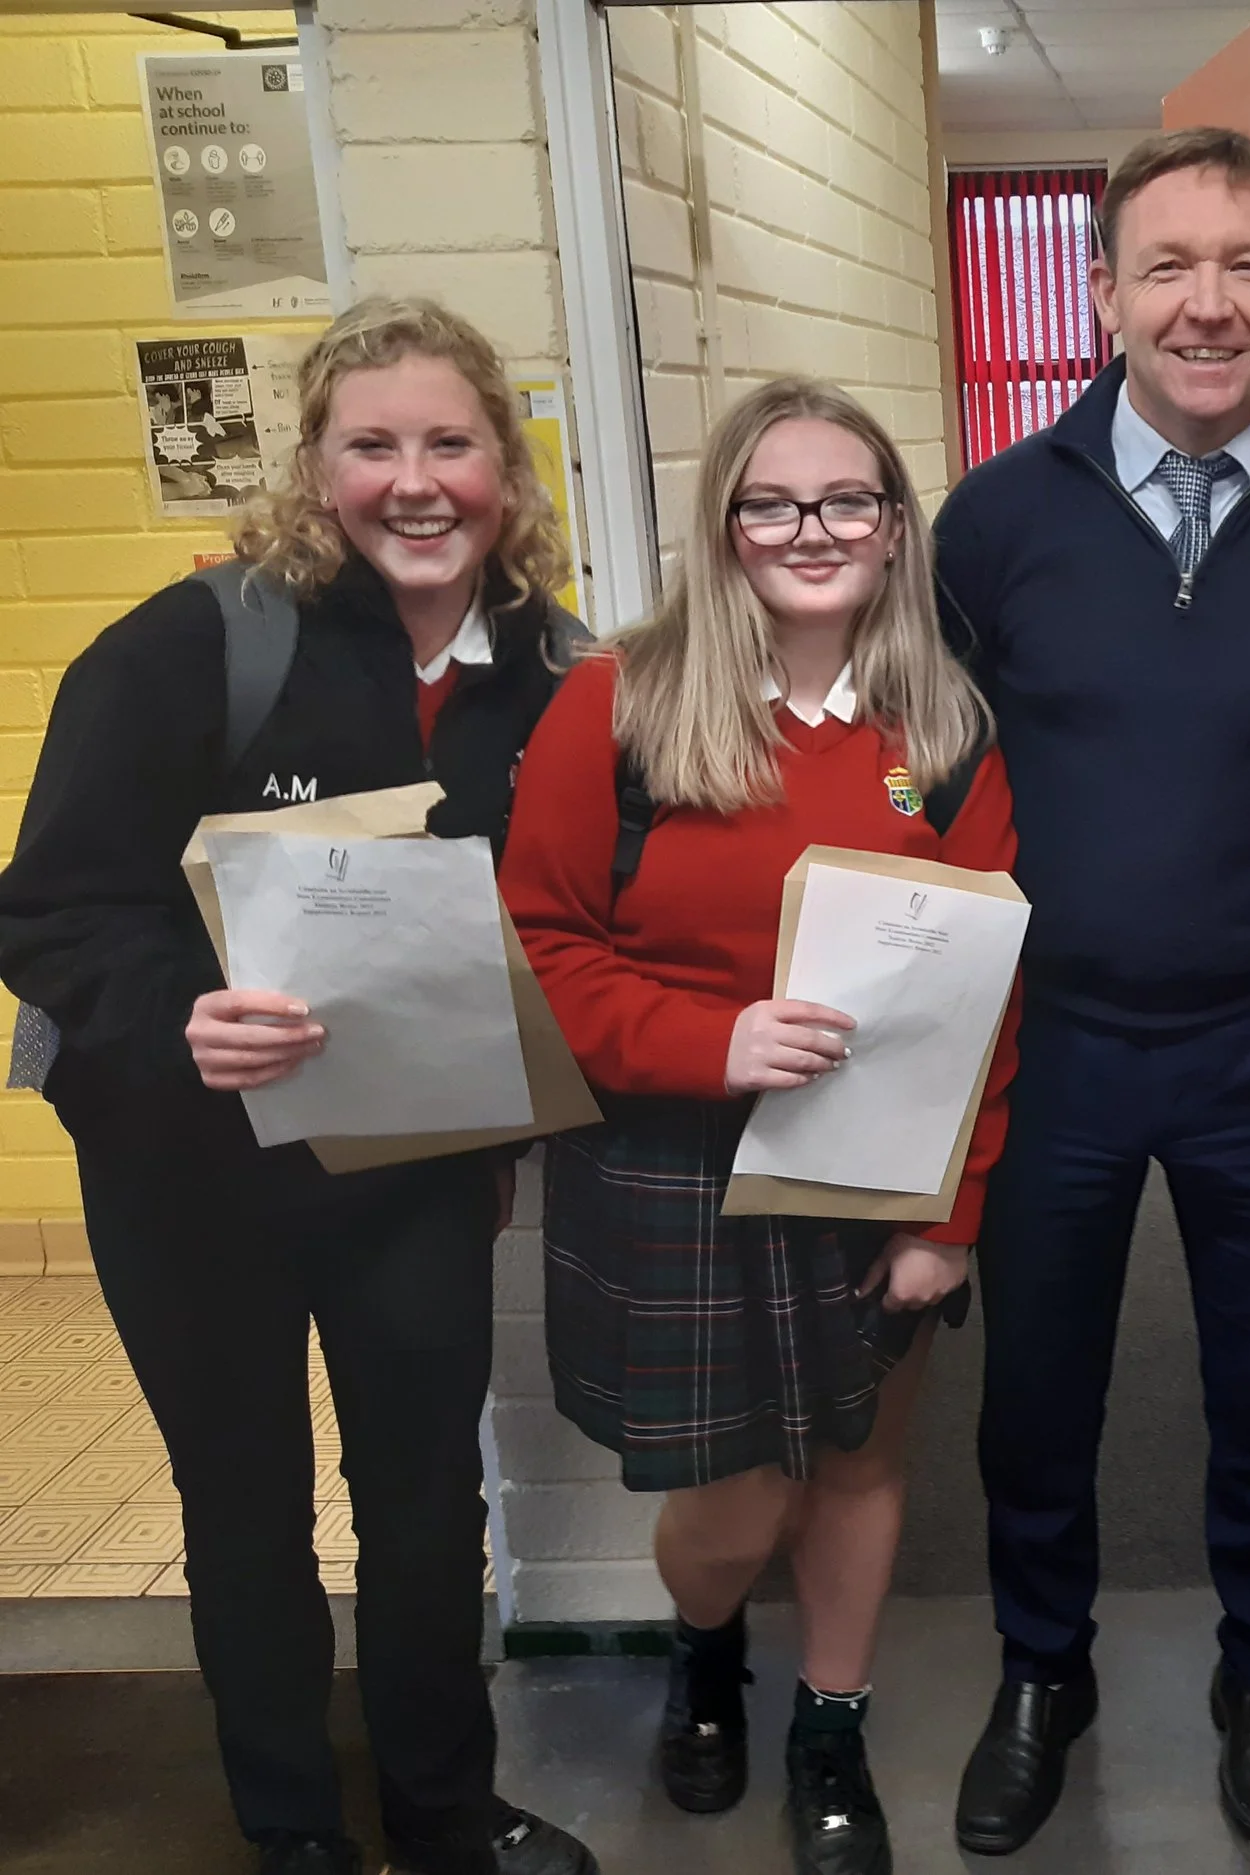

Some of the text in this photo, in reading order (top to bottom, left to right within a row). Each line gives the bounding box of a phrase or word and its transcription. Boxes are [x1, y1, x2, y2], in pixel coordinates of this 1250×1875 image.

[156, 87, 203, 101] When
[159, 102, 225, 119] at school
[161, 121, 251, 136] continue to:
[144, 341, 236, 364] COVER YOUR COUGH
[174, 355, 228, 372] AND SNEEZE
[262, 772, 318, 802] A.M
